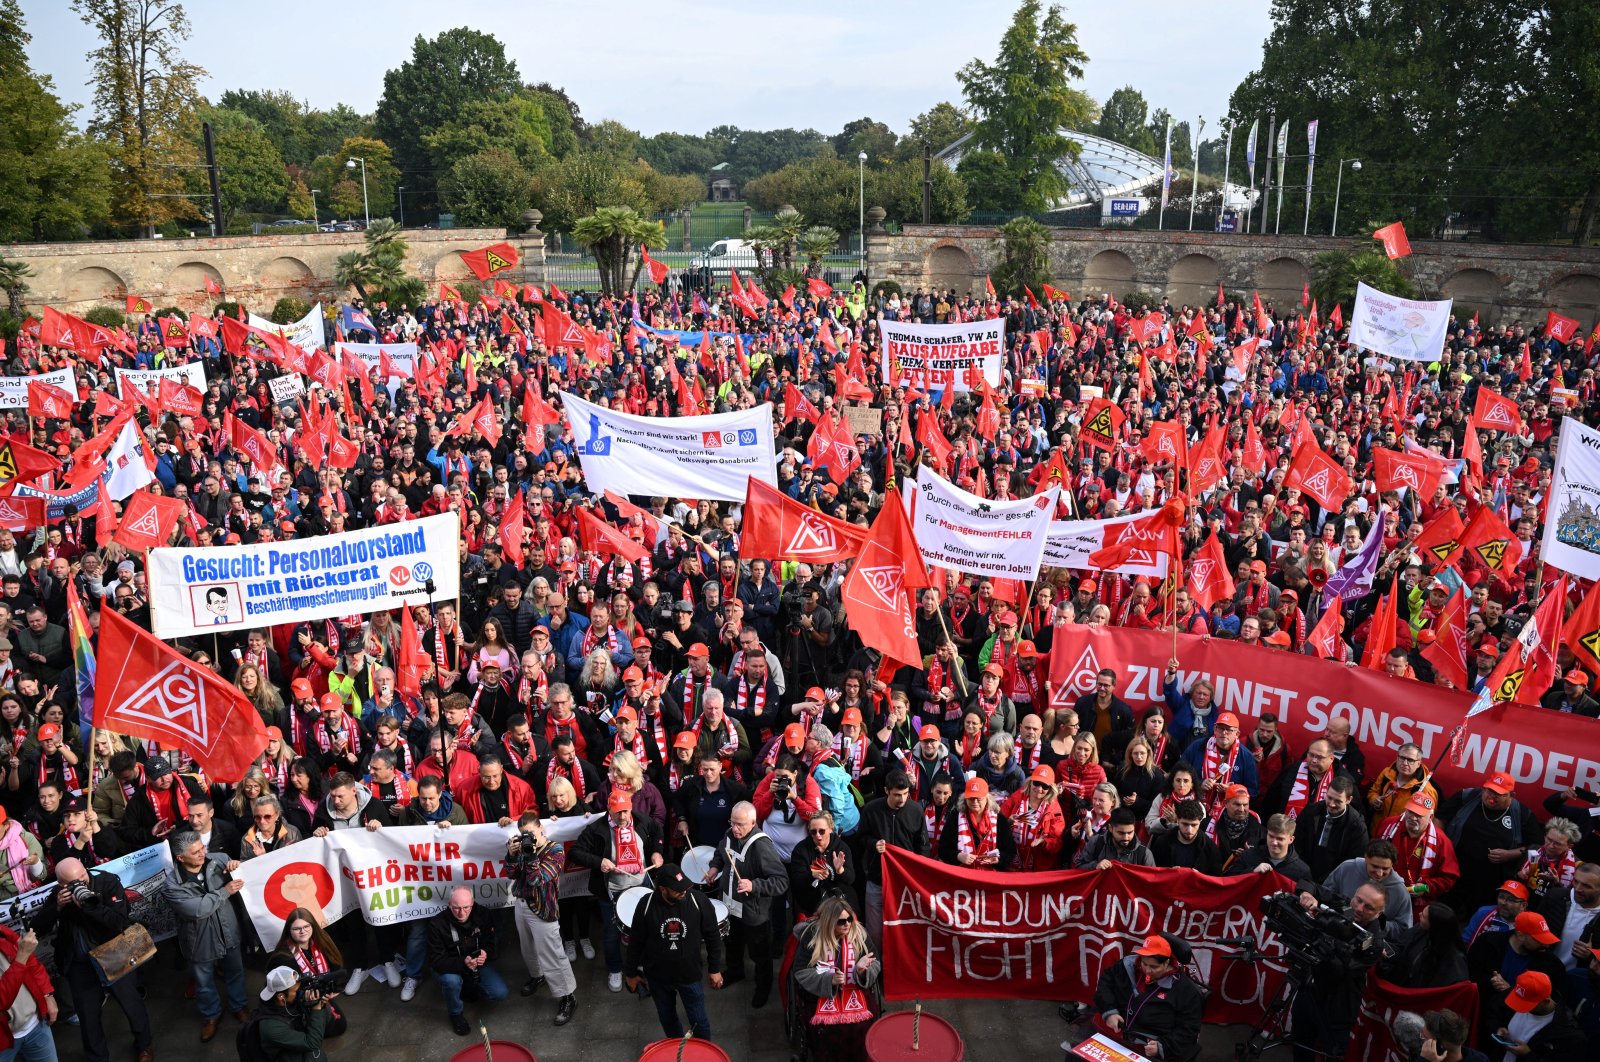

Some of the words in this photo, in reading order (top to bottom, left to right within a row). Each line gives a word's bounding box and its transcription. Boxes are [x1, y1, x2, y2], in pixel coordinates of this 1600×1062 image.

[888, 332, 922, 343] THOMAS
[968, 332, 984, 341] VW
[986, 331, 998, 340] AG
[890, 340, 1000, 360] HAUSAUFGABE
[271, 377, 290, 388] Dont
[646, 431, 661, 439] sind
[661, 433, 674, 441] wir
[676, 456, 718, 465] Volkswagen
[718, 456, 759, 465] Osnabrück!
[926, 492, 952, 508] Durch
[953, 504, 965, 513] die
[1005, 510, 1037, 521] gesagt:
[925, 514, 938, 525] Für
[939, 519, 1032, 540] ManagementFEHLER
[182, 553, 265, 583] Gesucht:
[268, 525, 427, 576] Personalvorstand
[943, 542, 974, 557] können
[991, 552, 1006, 560] nix.
[945, 555, 979, 568] endlich
[980, 563, 1006, 572] euren
[1007, 563, 1032, 575] Job!!!
[246, 579, 283, 598] mit
[284, 564, 381, 595] Rückgrat
[245, 586, 369, 616] Beschäftigungssicherung
[369, 581, 388, 600] gilt!
[1123, 663, 1299, 724] ZUKUNFT
[1302, 694, 1443, 760] SONST
[409, 842, 461, 862] WIR
[462, 859, 510, 882] DAZ
[369, 883, 509, 912] AUTOVION
[897, 885, 1084, 929] AUSBILDUNG
[1092, 889, 1154, 935] UND
[926, 926, 1067, 984] FIGHT
[1085, 1043, 1111, 1058] STATT
